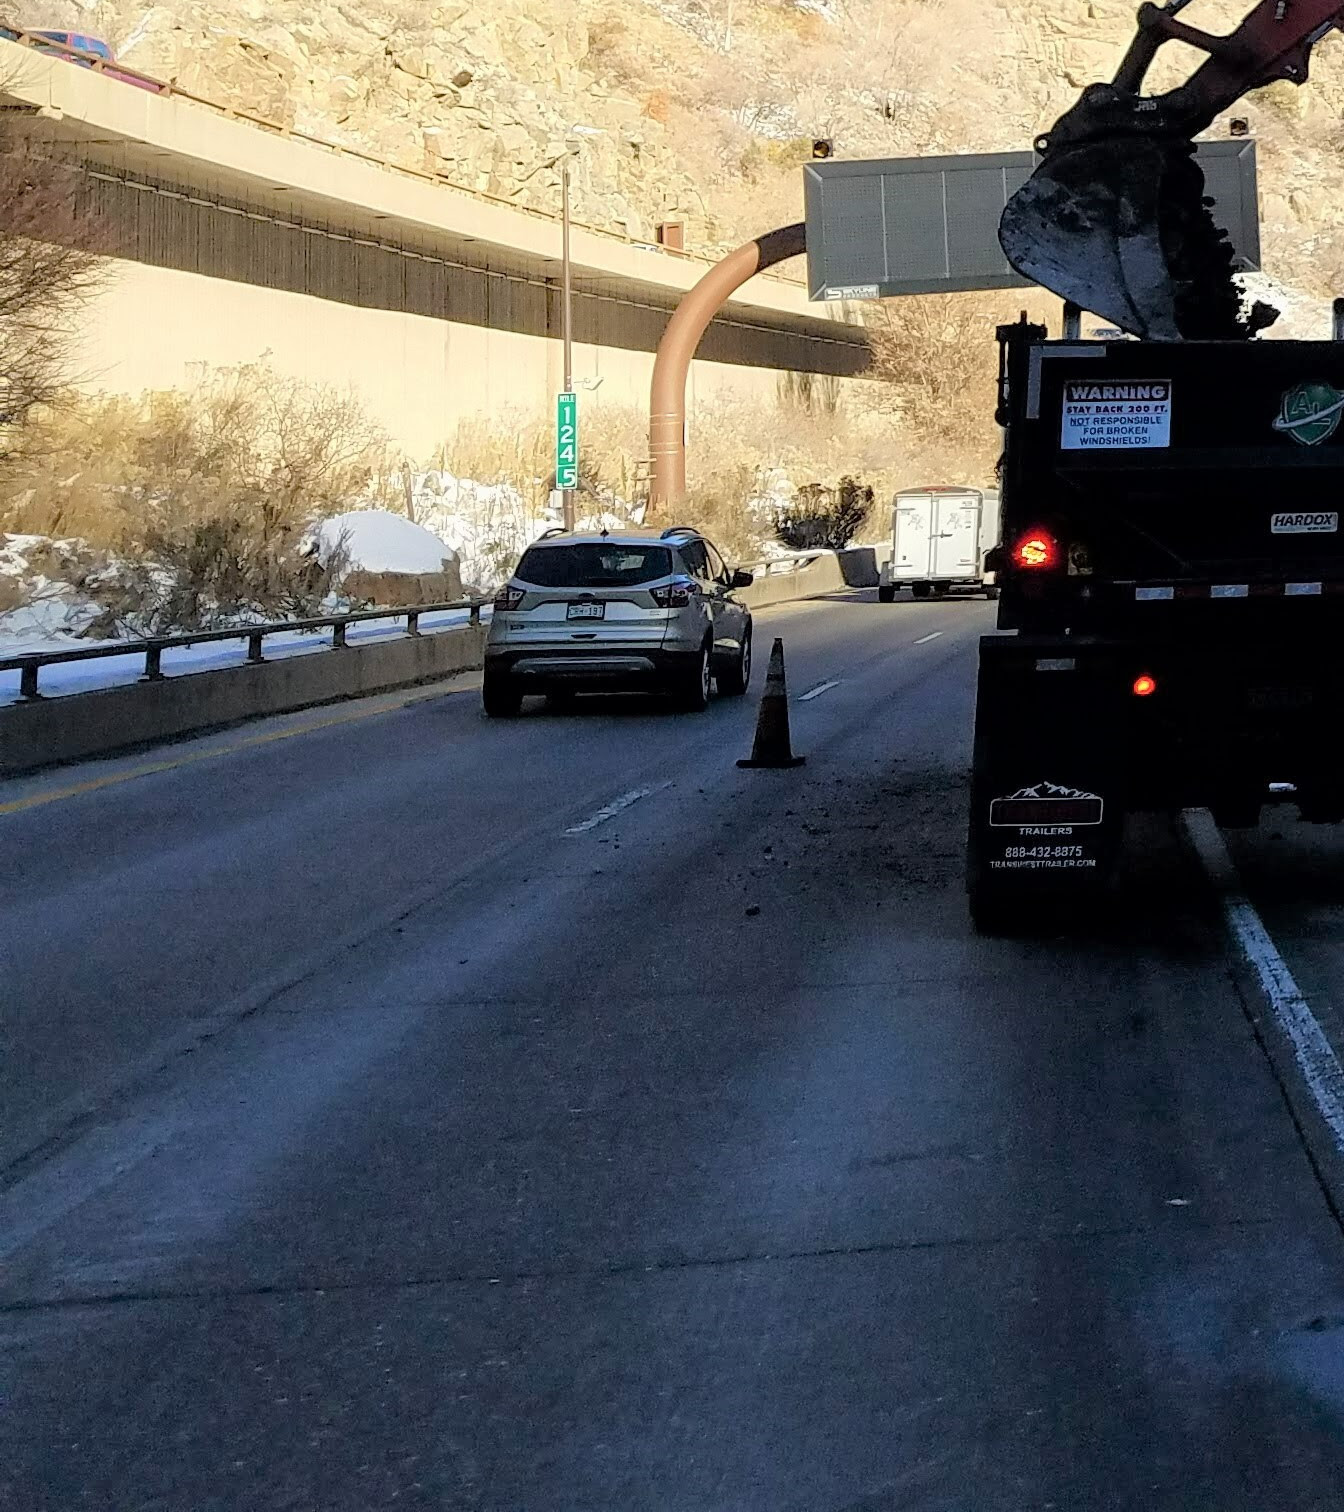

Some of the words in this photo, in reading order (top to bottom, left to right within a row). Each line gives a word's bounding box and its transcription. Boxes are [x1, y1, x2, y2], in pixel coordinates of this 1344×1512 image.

[1071, 386, 1166, 400] WARNING
[1067, 406, 1091, 414] STAY
[1128, 405, 1150, 413] 200
[1154, 405, 1168, 413] FT.
[1070, 417, 1090, 427] NOT
[1093, 416, 1162, 426] RESPONSIBLE
[1083, 427, 1104, 436] FOR
[1106, 426, 1149, 435] BROKEN
[1274, 514, 1333, 527] HARDOX
[1019, 827, 1073, 836] TRAILERS
[1005, 846, 1083, 858] 888-432-8875
